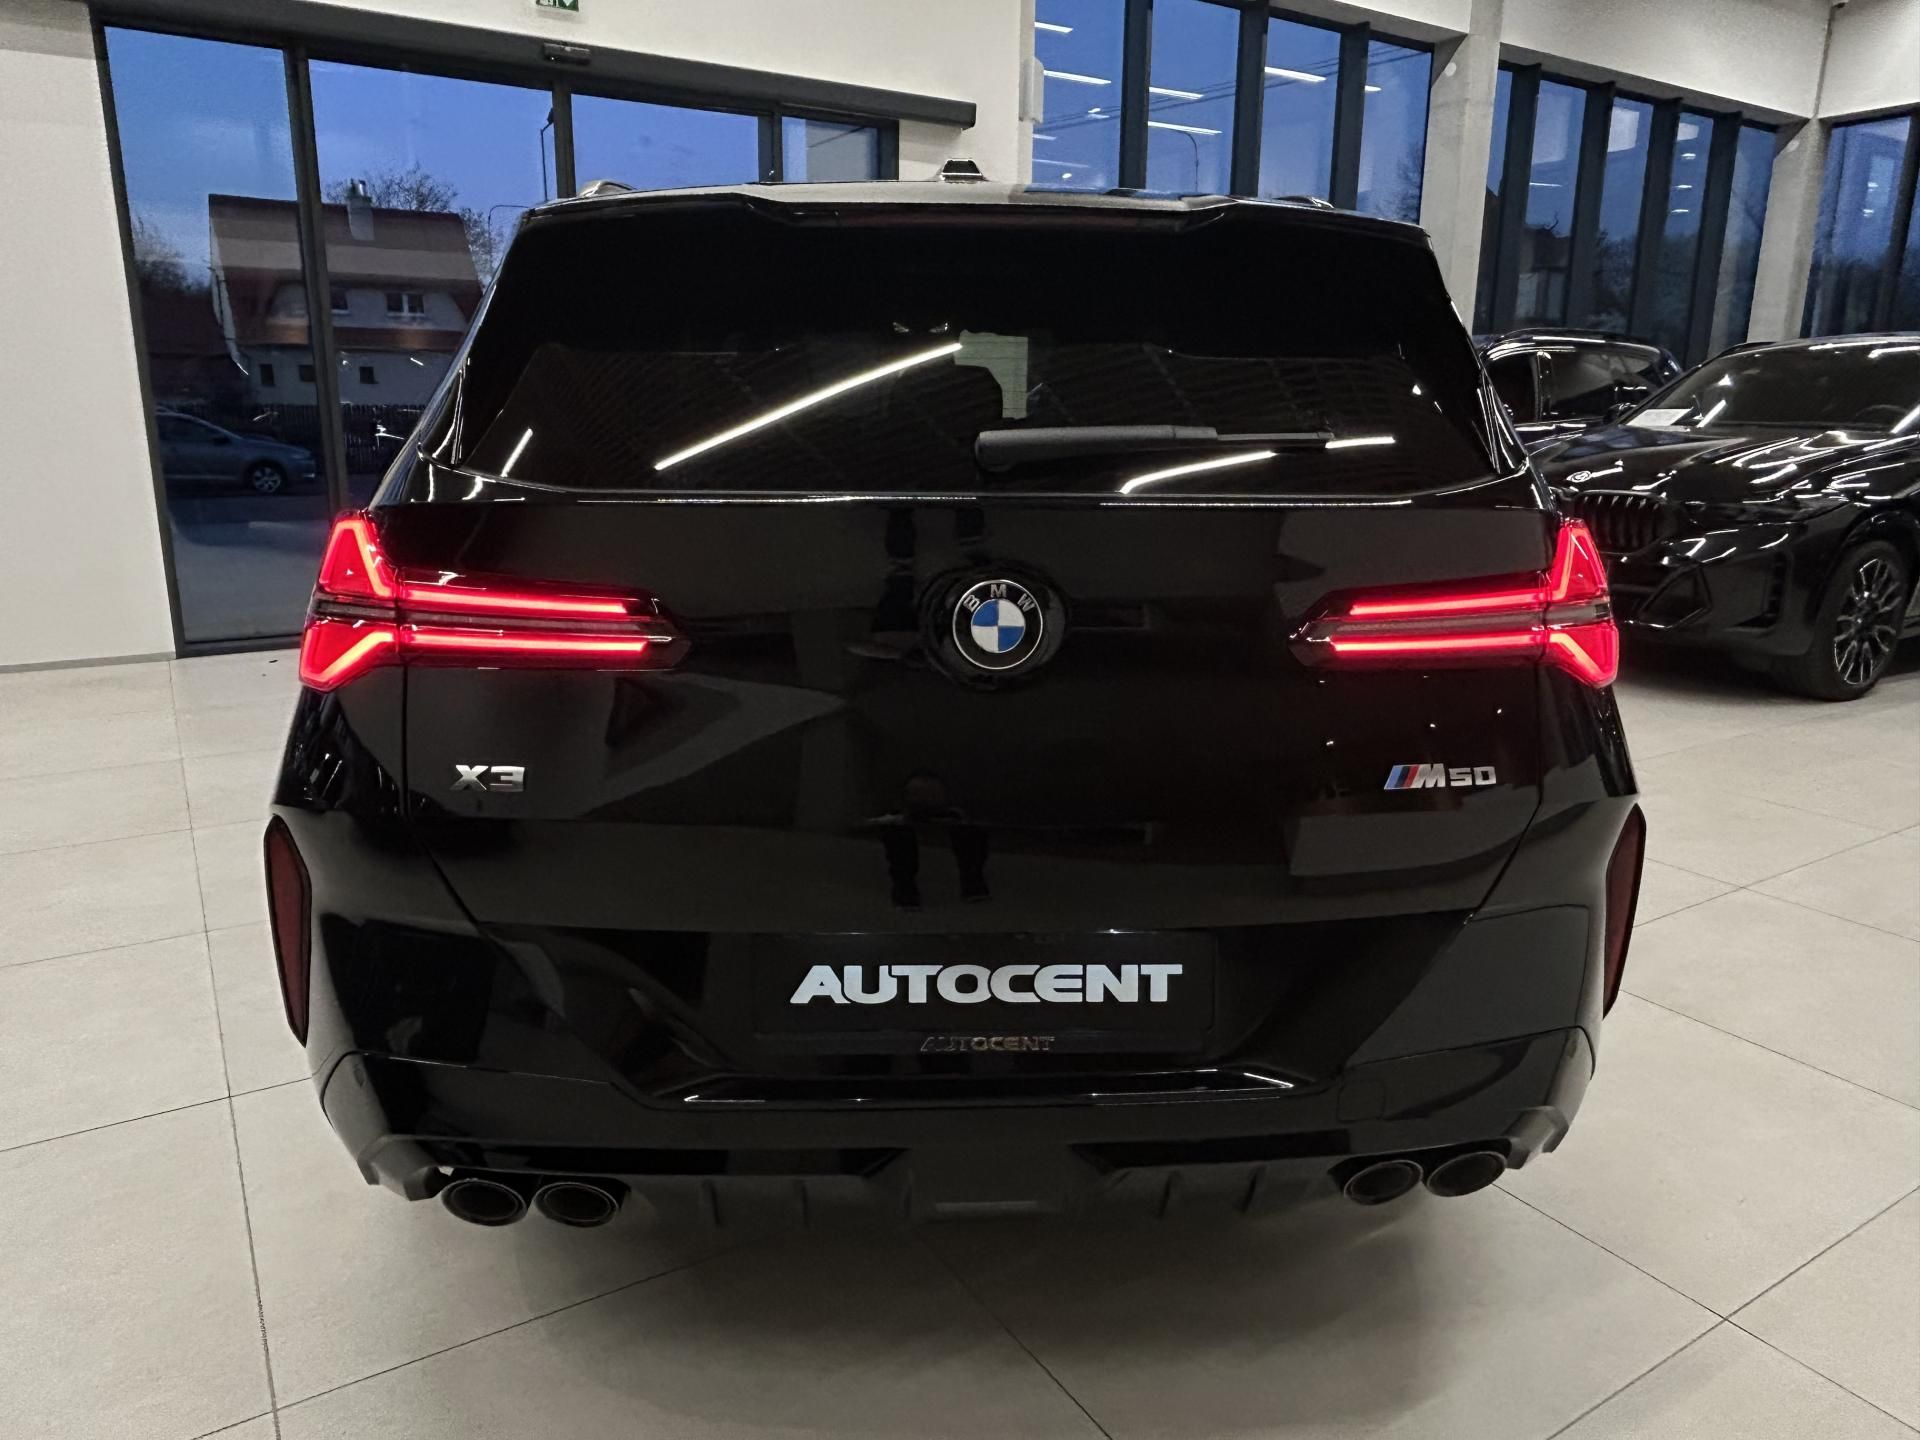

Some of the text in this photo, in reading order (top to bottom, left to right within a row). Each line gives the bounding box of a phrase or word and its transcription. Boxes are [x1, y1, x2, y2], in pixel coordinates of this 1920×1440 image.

[962, 583, 1036, 613] BMW
[449, 764, 526, 793] X3
[1408, 762, 1497, 789] M50
[789, 964, 1183, 1004] AUTOCENT
[920, 1036, 1056, 1052] AUTOCENT
